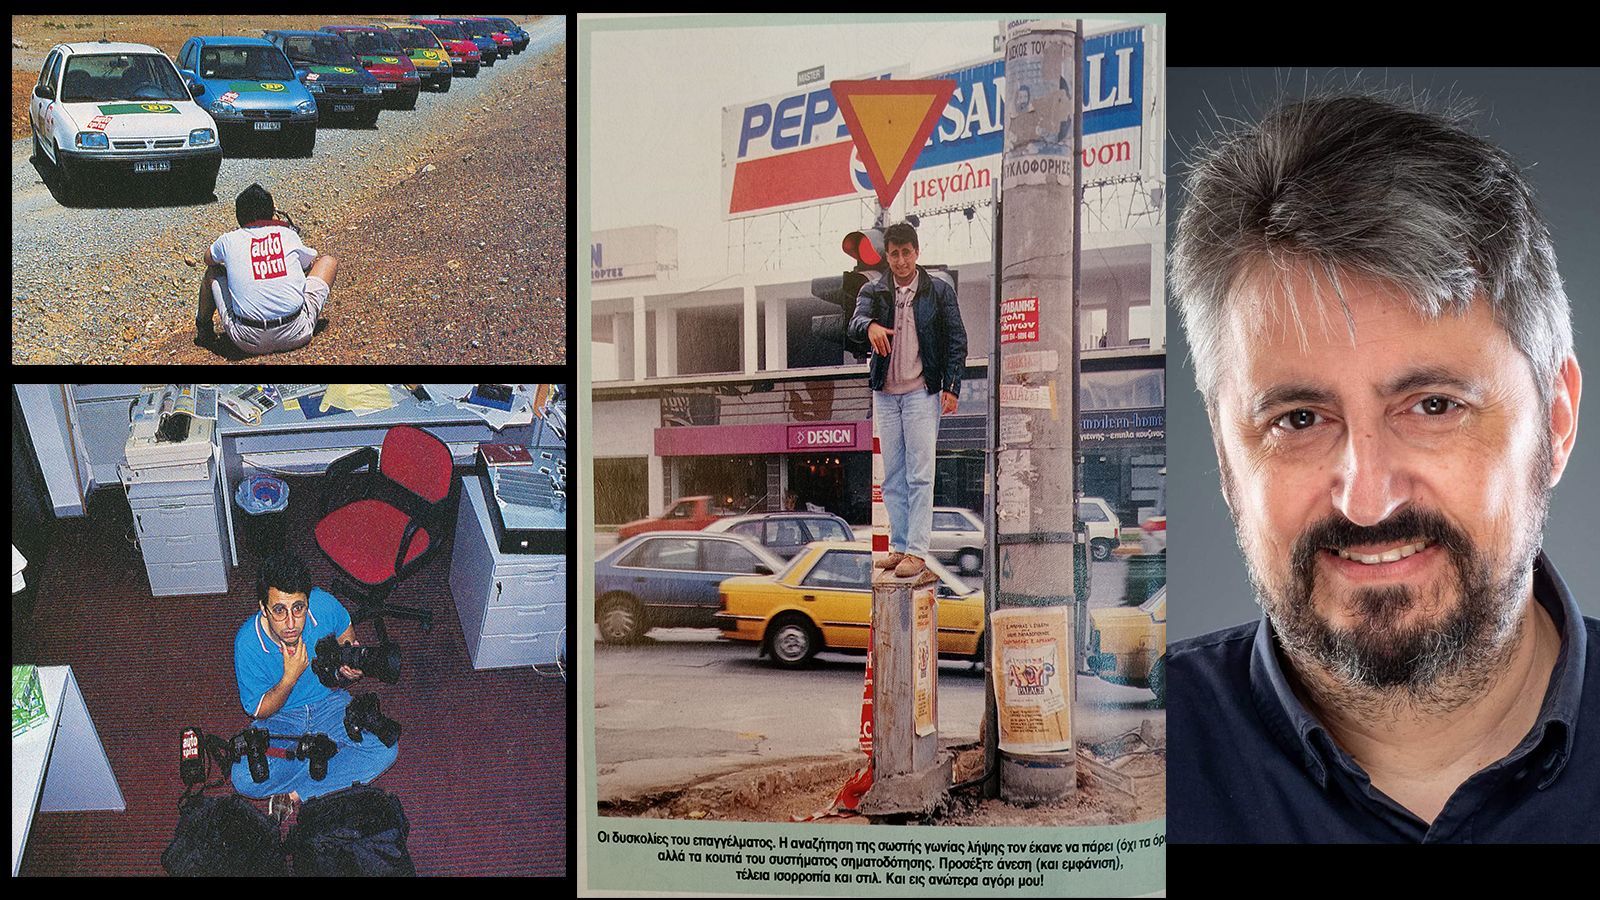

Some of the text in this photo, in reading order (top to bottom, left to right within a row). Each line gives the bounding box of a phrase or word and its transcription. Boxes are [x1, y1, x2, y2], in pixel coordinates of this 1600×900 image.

[1003, 158, 1071, 179] ΥΚΛΟΦΟΡΗΣΕ
[913, 163, 990, 206] μεγάλη
[251, 233, 281, 257] auto
[253, 255, 285, 278] τρίτη
[807, 429, 850, 444] DESIGN
[598, 831, 609, 843] Οι
[612, 831, 669, 845] δυσκολίες
[671, 836, 690, 846] του
[693, 835, 776, 851] επαγγέλματος.
[779, 837, 788, 848] Η
[791, 837, 853, 853] αναζήτηση
[856, 842, 875, 853] της
[878, 840, 921, 854] σωστής
[924, 840, 965, 855] γωνίας
[967, 840, 1005, 856] λήψης
[1007, 842, 1027, 853] τον
[1029, 839, 1063, 853] έκανε
[1065, 843, 1079, 853] να
[1082, 840, 1113, 854] πάρει
[1117, 838, 1136, 854] (όχι
[1139, 838, 1151, 848] τα
[658, 849, 1123, 872] αλλά τα κουτιά του συστήματος σηματοδότησης. Προσέξτε άνεση (και εμφάνιση),
[736, 868, 1044, 889] τέλεια ισορροπία και στιλ. Και εις ανώτερα αγόρι μου!
